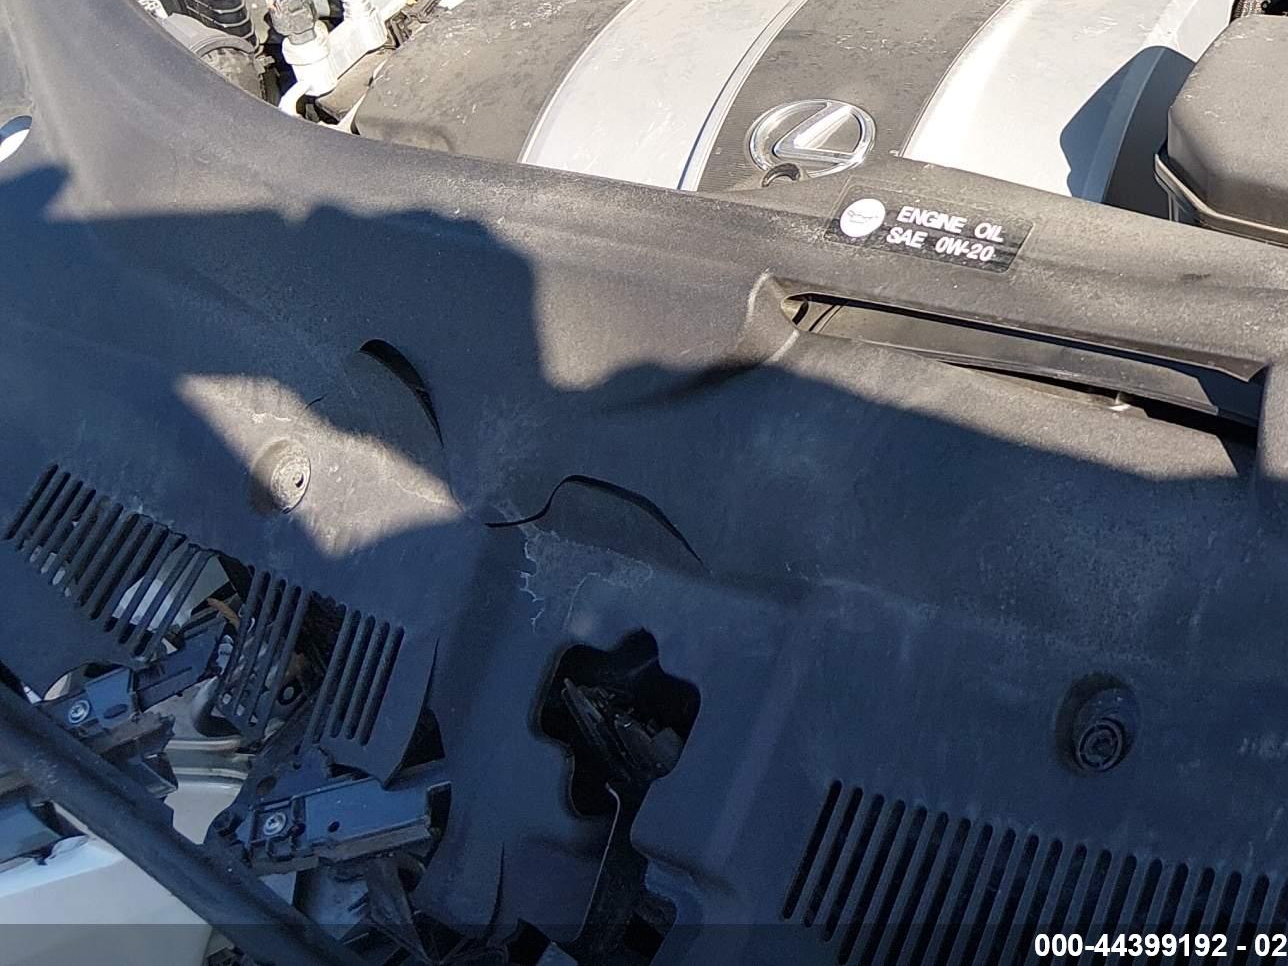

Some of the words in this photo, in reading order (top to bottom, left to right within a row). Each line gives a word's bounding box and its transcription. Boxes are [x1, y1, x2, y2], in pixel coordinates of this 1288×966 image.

[896, 205, 967, 234] ENGINE
[974, 222, 1005, 243] OIL
[886, 226, 928, 249] SAE
[934, 236, 995, 262] 0W-20
